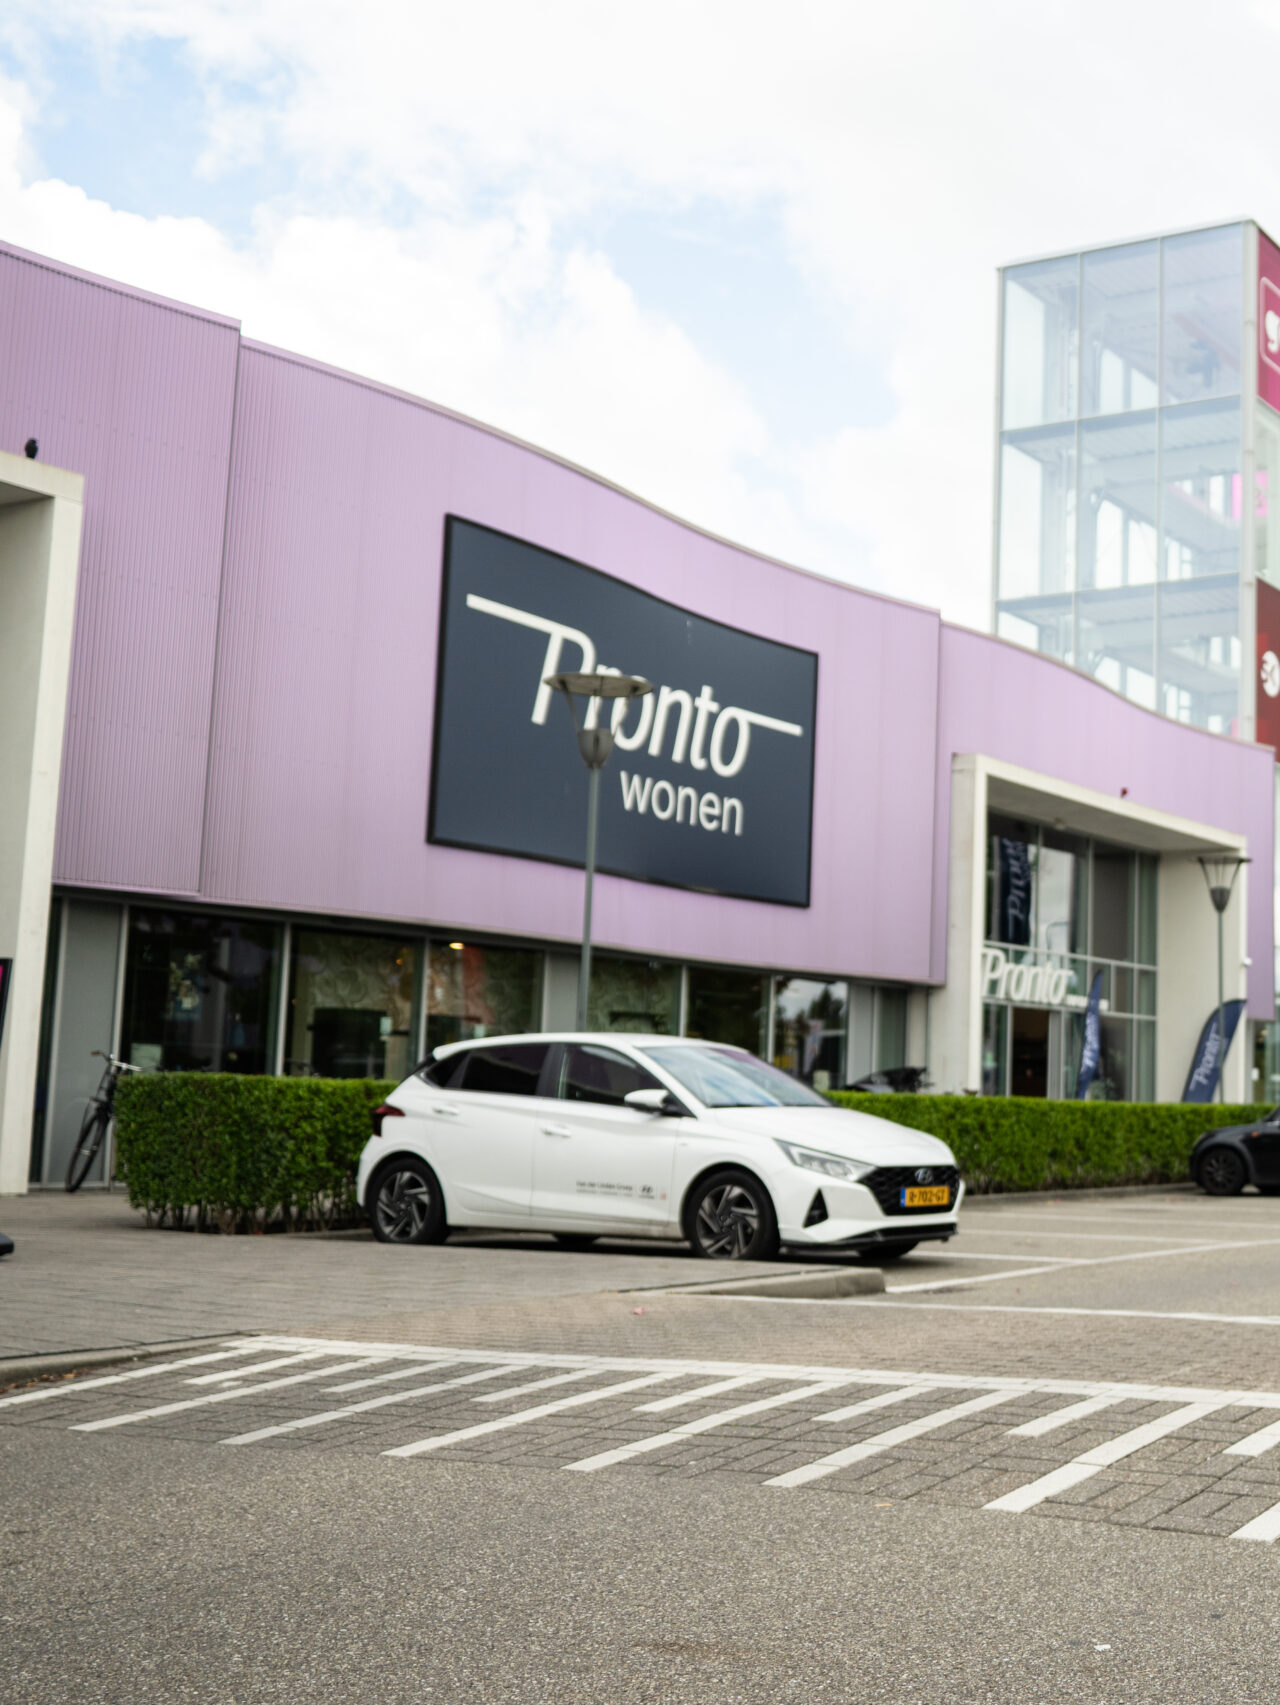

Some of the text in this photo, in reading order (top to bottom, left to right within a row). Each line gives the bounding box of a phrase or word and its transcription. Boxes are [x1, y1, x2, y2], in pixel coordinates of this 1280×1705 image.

[465, 592, 804, 779] Pronto
[619, 769, 745, 837] wonen
[981, 946, 1075, 1006] Pronto
